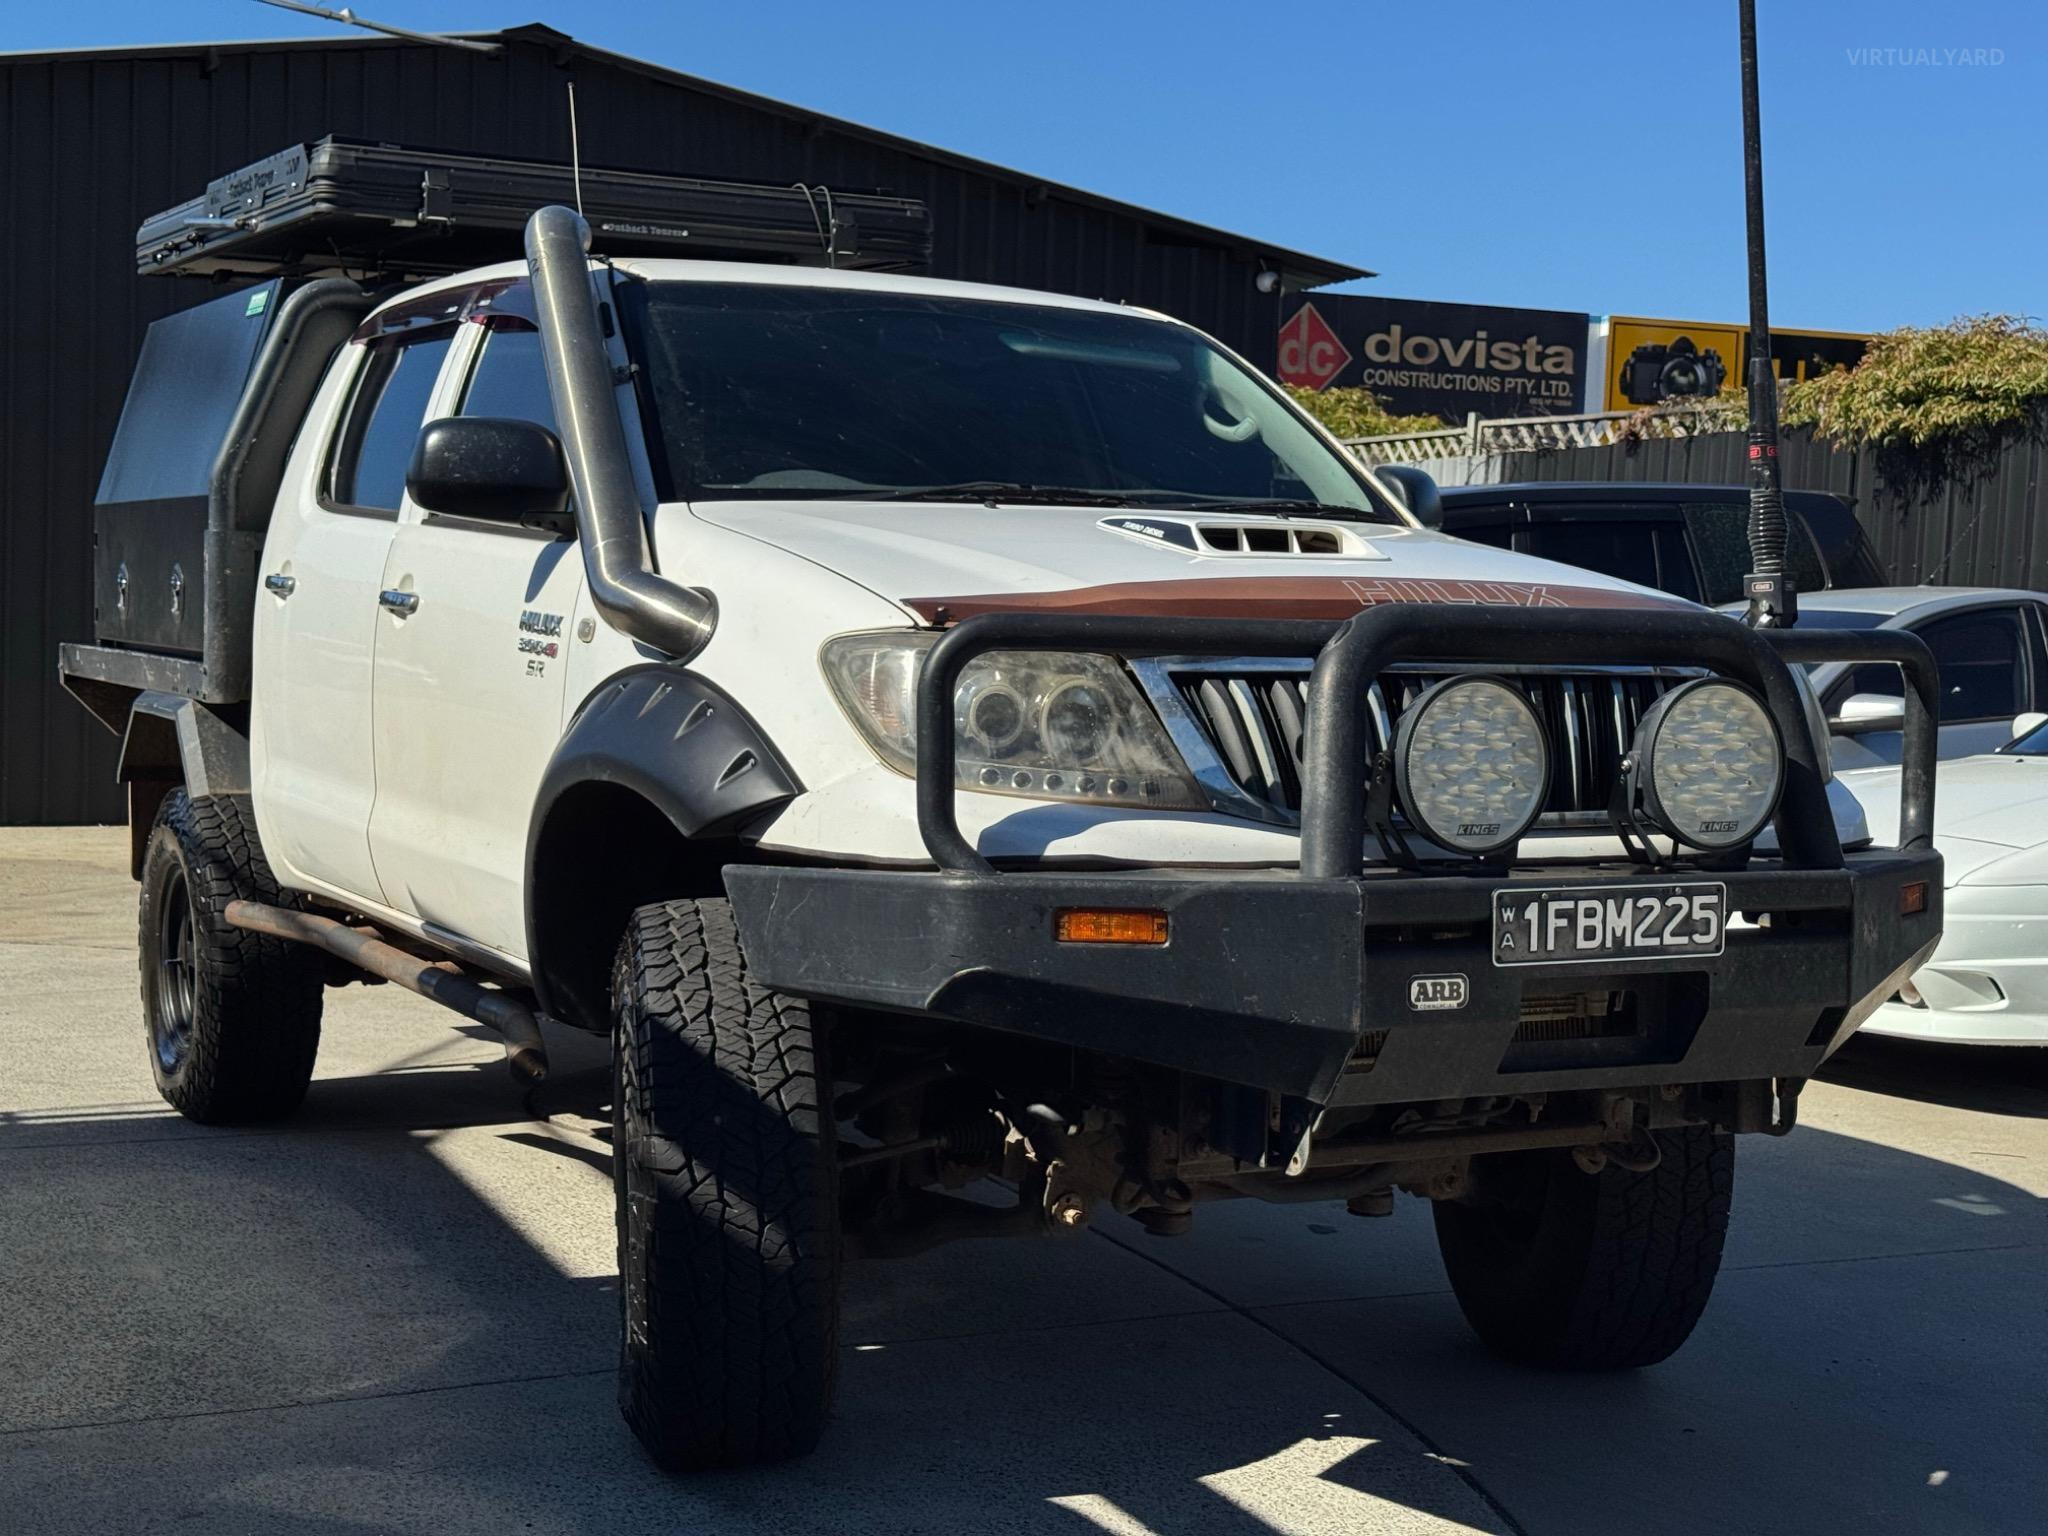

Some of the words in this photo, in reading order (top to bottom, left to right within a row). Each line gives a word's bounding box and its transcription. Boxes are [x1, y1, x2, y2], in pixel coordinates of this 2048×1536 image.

[1278, 303, 1334, 376] dc
[1364, 324, 1575, 375] dovista
[1363, 368, 1501, 393] CONSTRUCTIONS
[1504, 377, 1537, 395] PTY.
[1540, 380, 1574, 397] LTD.
[1342, 579, 1569, 608] HILUX
[1457, 824, 1500, 836] KINGS
[1700, 821, 1738, 832] KINGS
[1524, 894, 1720, 952] 1FBM225
[1414, 981, 1462, 1003] ARB
